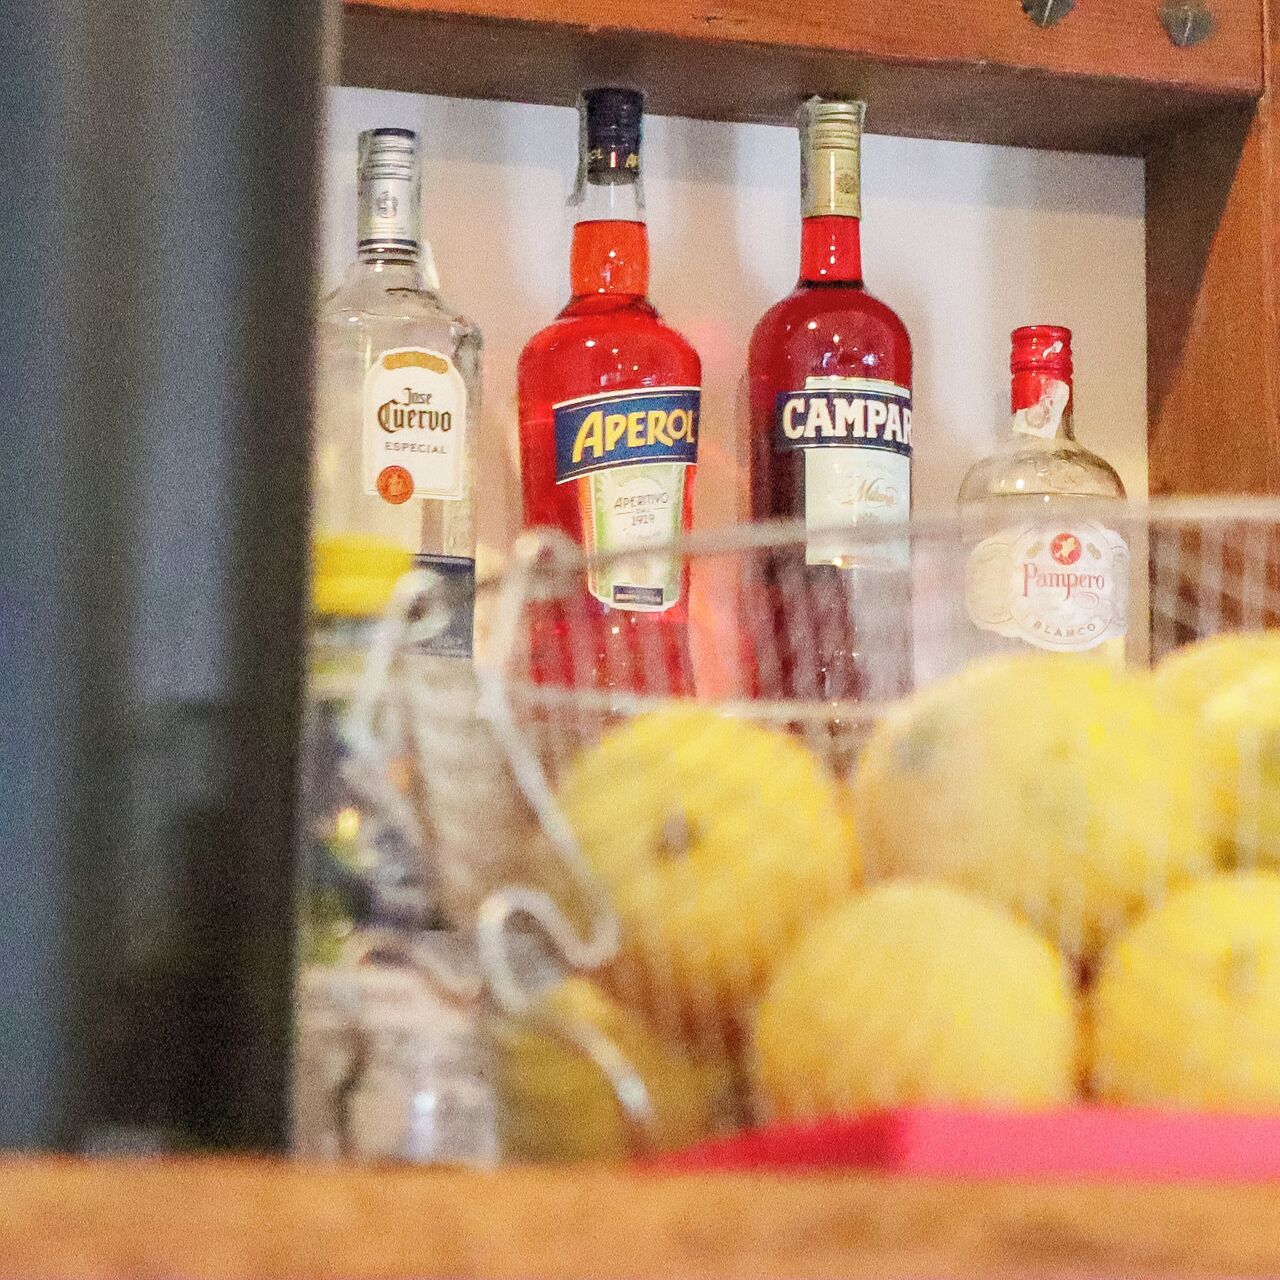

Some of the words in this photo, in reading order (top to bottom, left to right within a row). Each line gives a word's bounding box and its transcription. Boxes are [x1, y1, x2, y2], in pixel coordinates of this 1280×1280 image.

[377, 399, 452, 433] Cuervo
[384, 441, 447, 455] ESPECIAL
[572, 409, 695, 463] APEROL
[1023, 563, 1105, 600] Pampero
[1034, 621, 1096, 637] BLANCO
